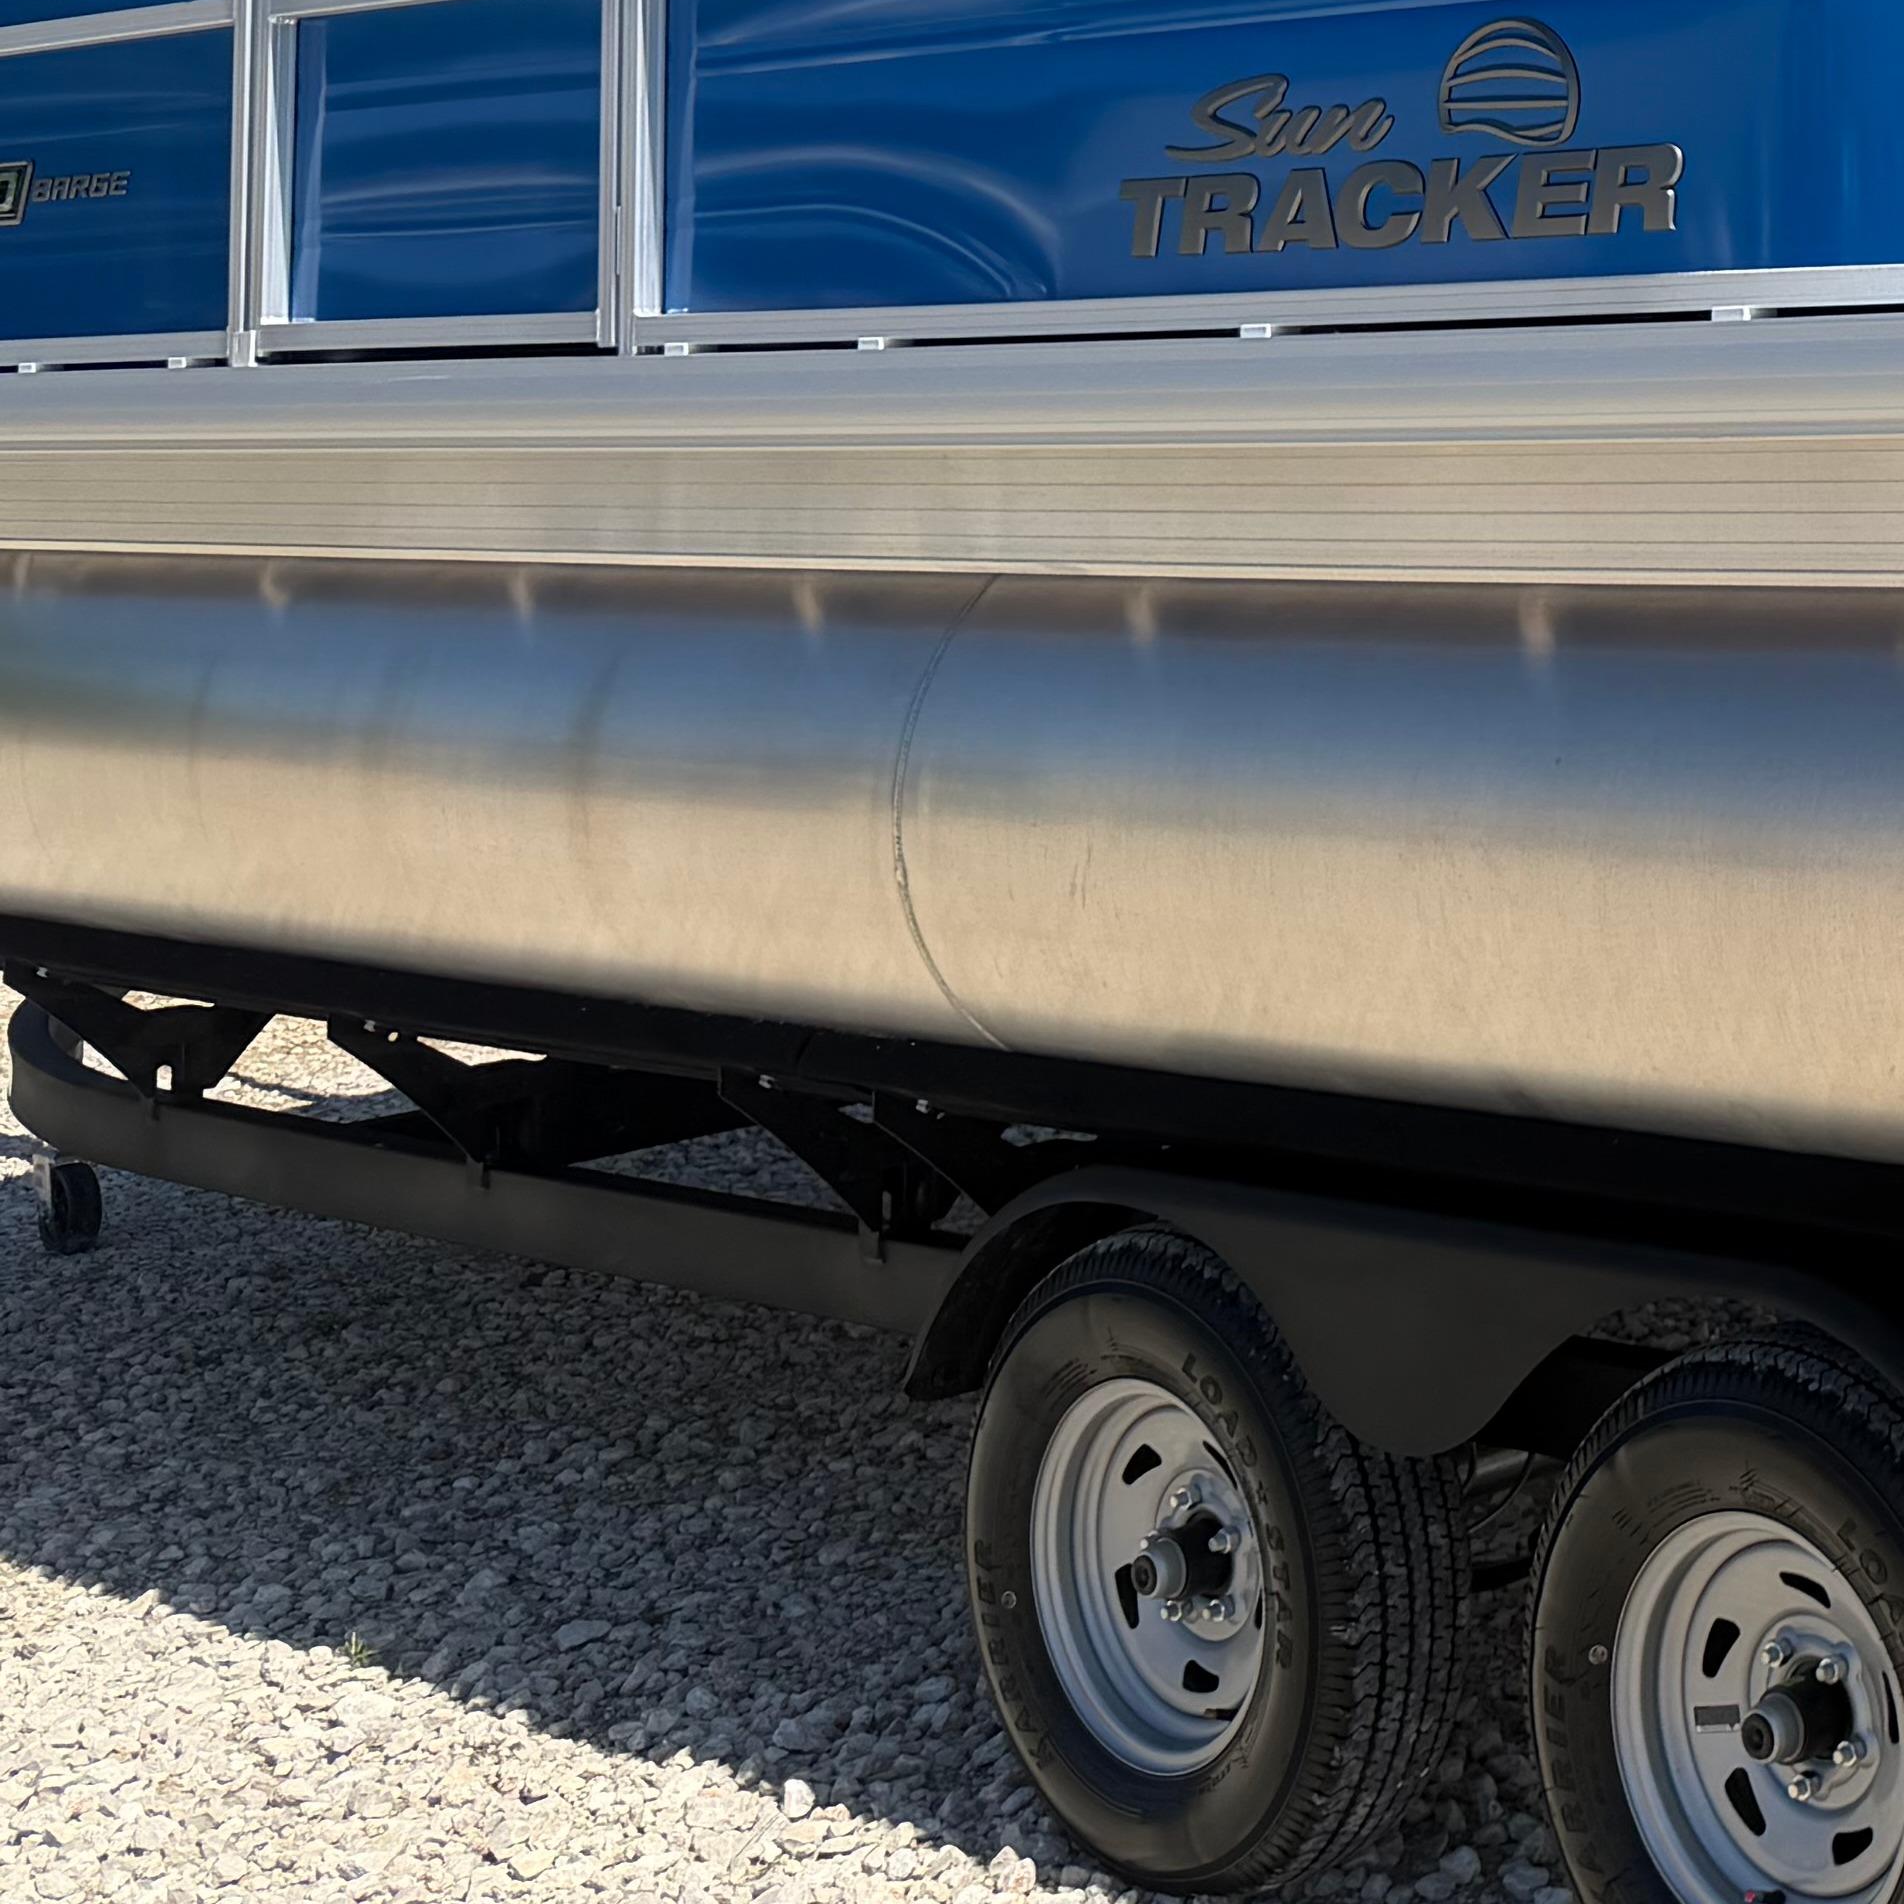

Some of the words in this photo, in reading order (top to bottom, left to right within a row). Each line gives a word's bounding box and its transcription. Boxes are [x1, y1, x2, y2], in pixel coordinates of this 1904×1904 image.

[1165, 72, 1397, 162] Sun
[32, 170, 132, 203] BARGE
[1119, 142, 1685, 259] TRACKER
[1182, 1351, 1260, 1473] LOAD
[1265, 1519, 1295, 1670] STAR
